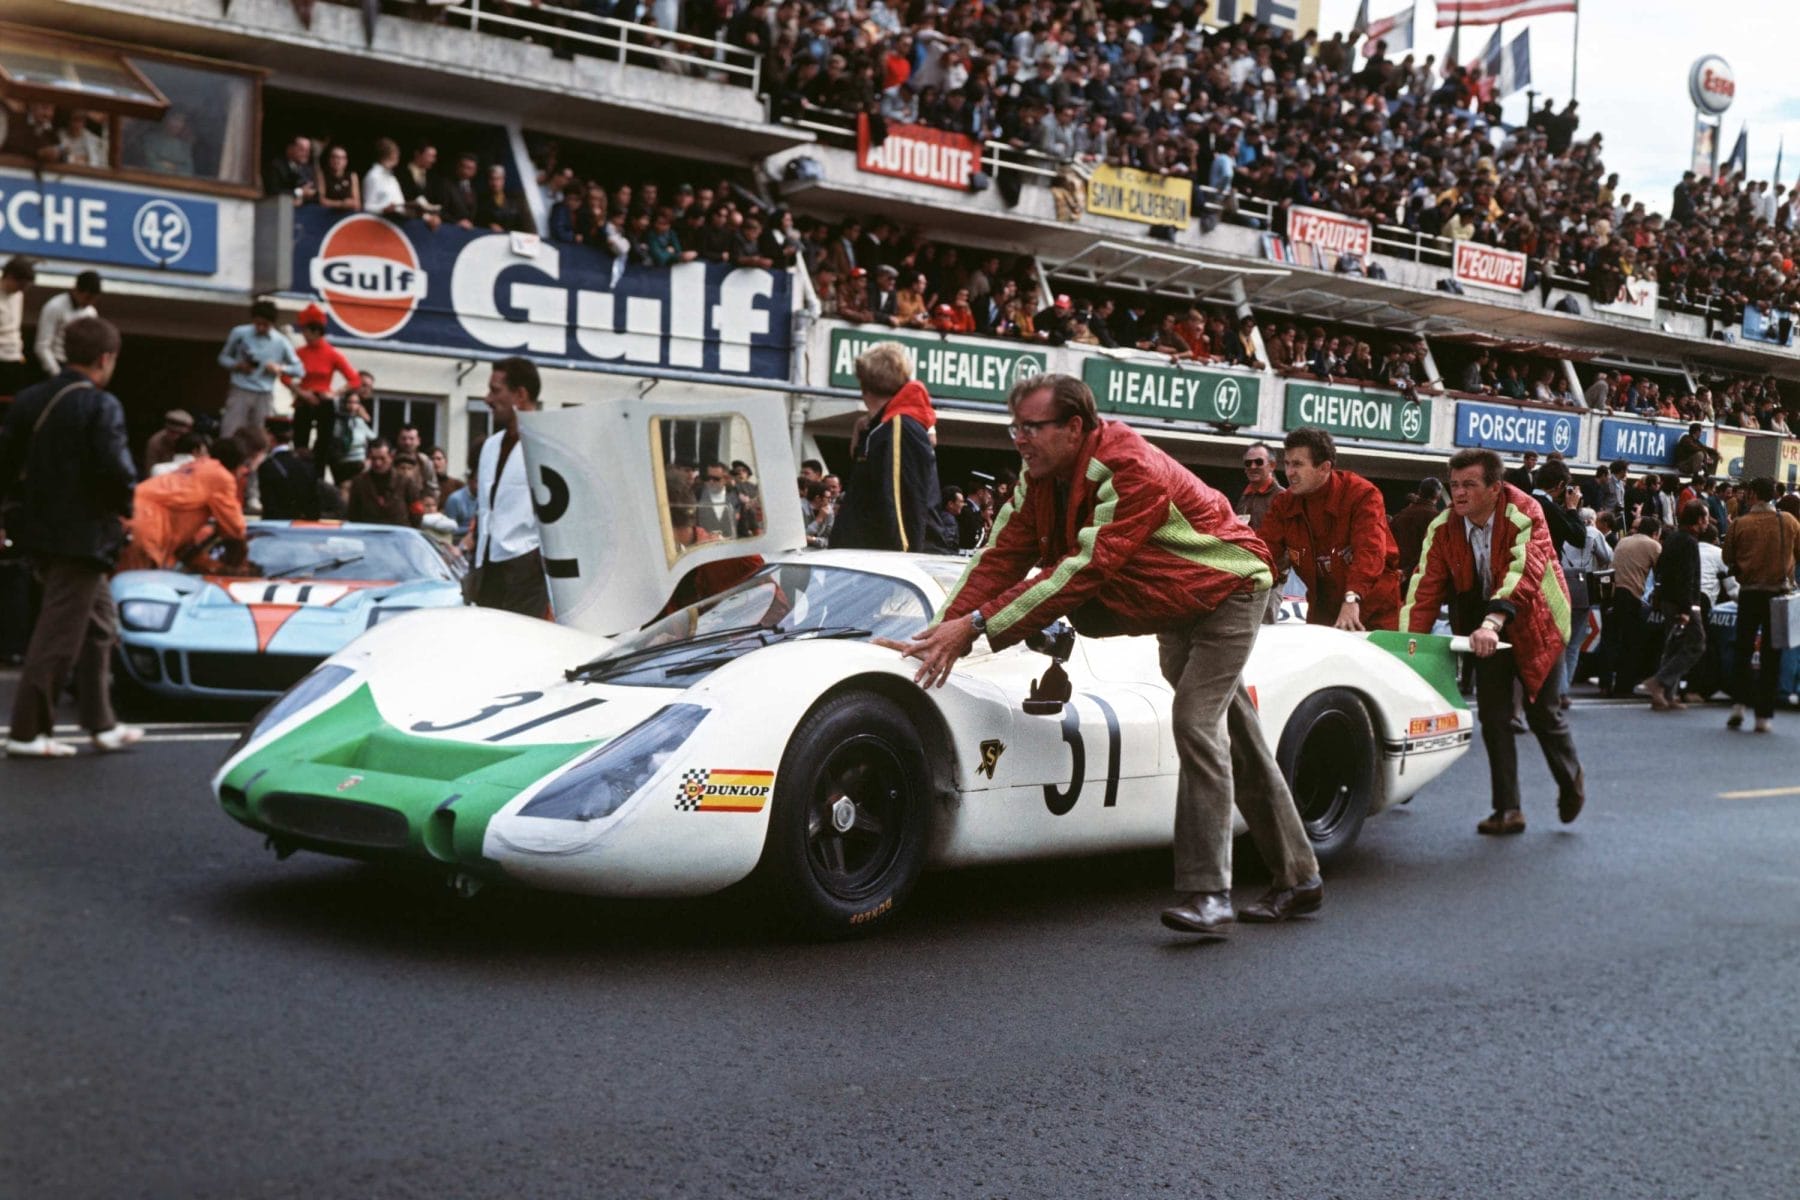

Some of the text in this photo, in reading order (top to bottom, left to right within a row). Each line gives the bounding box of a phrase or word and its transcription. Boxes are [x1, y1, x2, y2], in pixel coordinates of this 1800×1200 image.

[866, 135, 972, 185] AUTOLITE
[141, 210, 182, 251] 42
[322, 262, 415, 291] Gulf
[451, 233, 774, 372] Gulf
[1108, 369, 1237, 411] HEALEY 47
[1300, 393, 1419, 432] CHEVRON 25
[1469, 412, 1569, 446] PORSCHE 64
[1616, 428, 1666, 457] MATRA
[705, 785, 770, 796] DUNLOP
